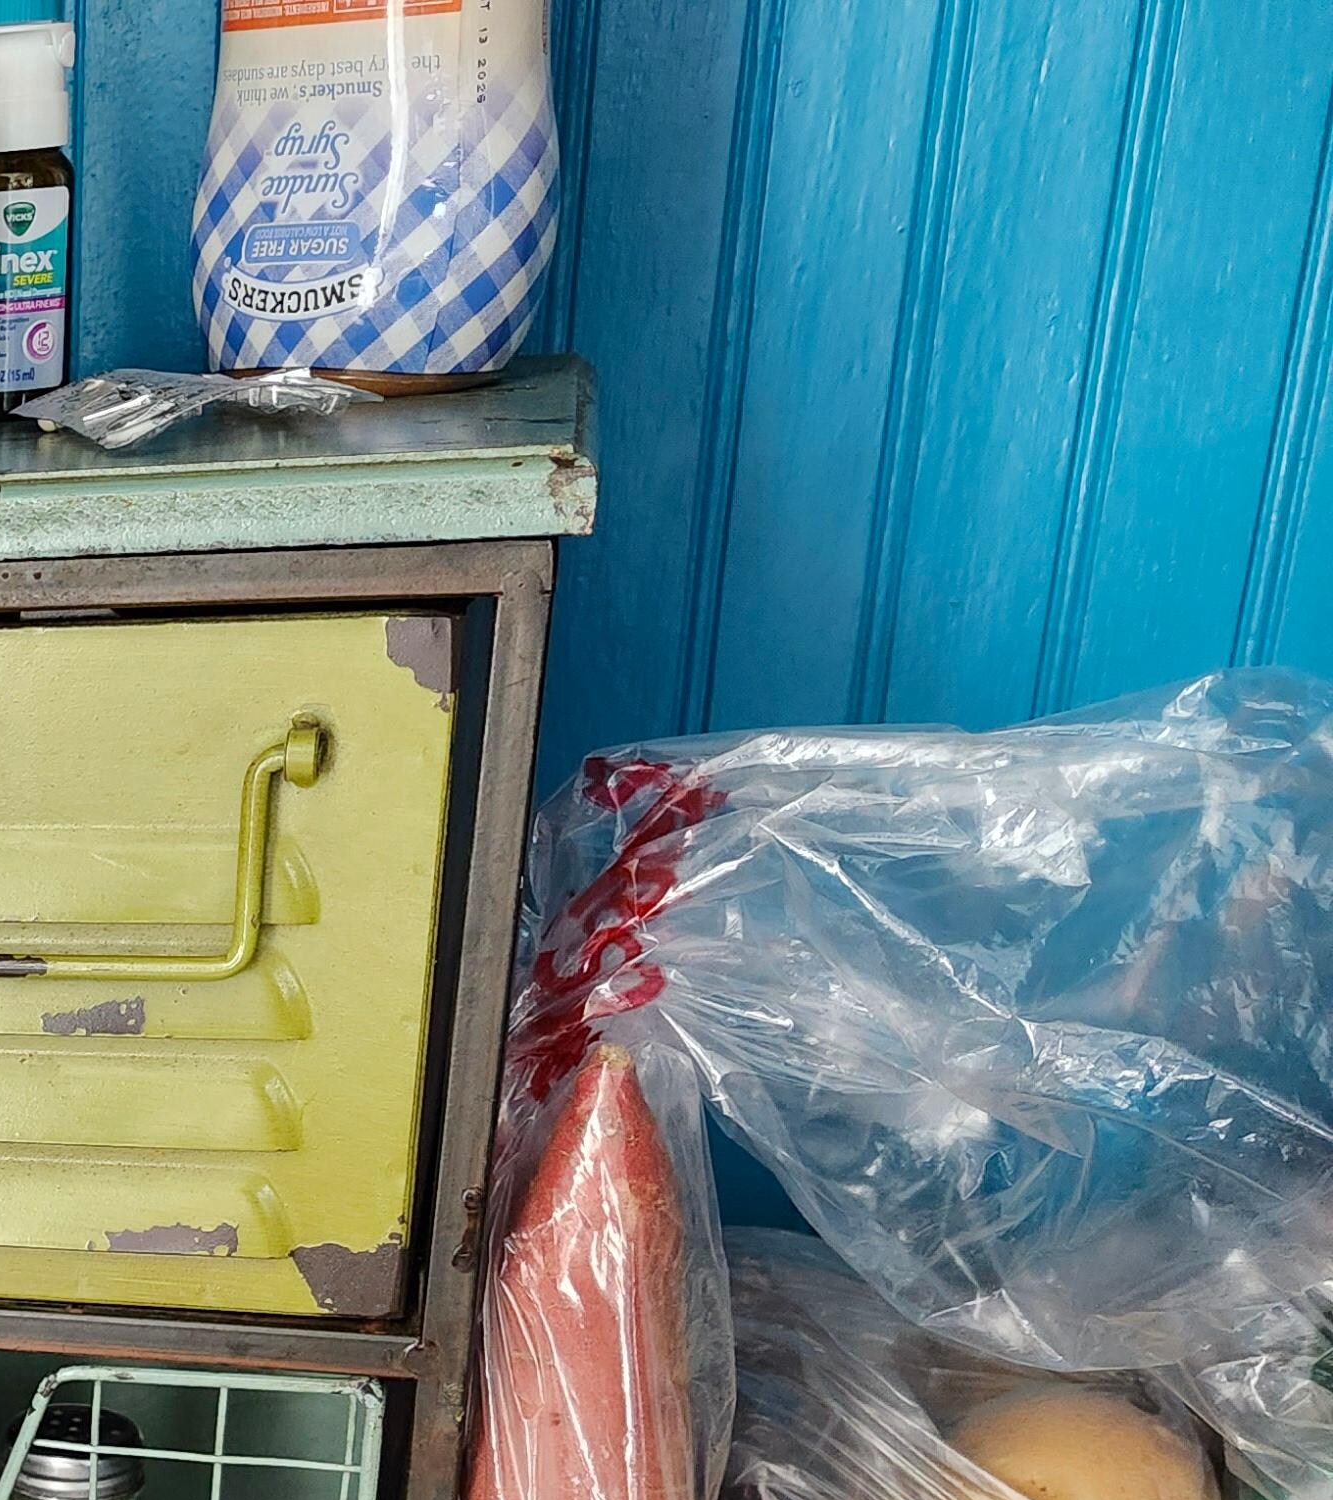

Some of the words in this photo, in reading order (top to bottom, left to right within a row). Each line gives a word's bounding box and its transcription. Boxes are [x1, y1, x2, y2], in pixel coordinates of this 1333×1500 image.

[267, 65, 288, 79] are
[291, 60, 325, 81] days
[332, 58, 364, 76] best
[411, 54, 441, 73] the
[235, 87, 267, 107] think
[269, 88, 289, 100] we
[273, 119, 350, 170] Syrup
[261, 170, 360, 214] Sundae
[5, 212, 33, 223] VICKS
[251, 239, 285, 258] FREE
[289, 236, 350, 256] SUGAR
[13, 272, 53, 287] SEVERE
